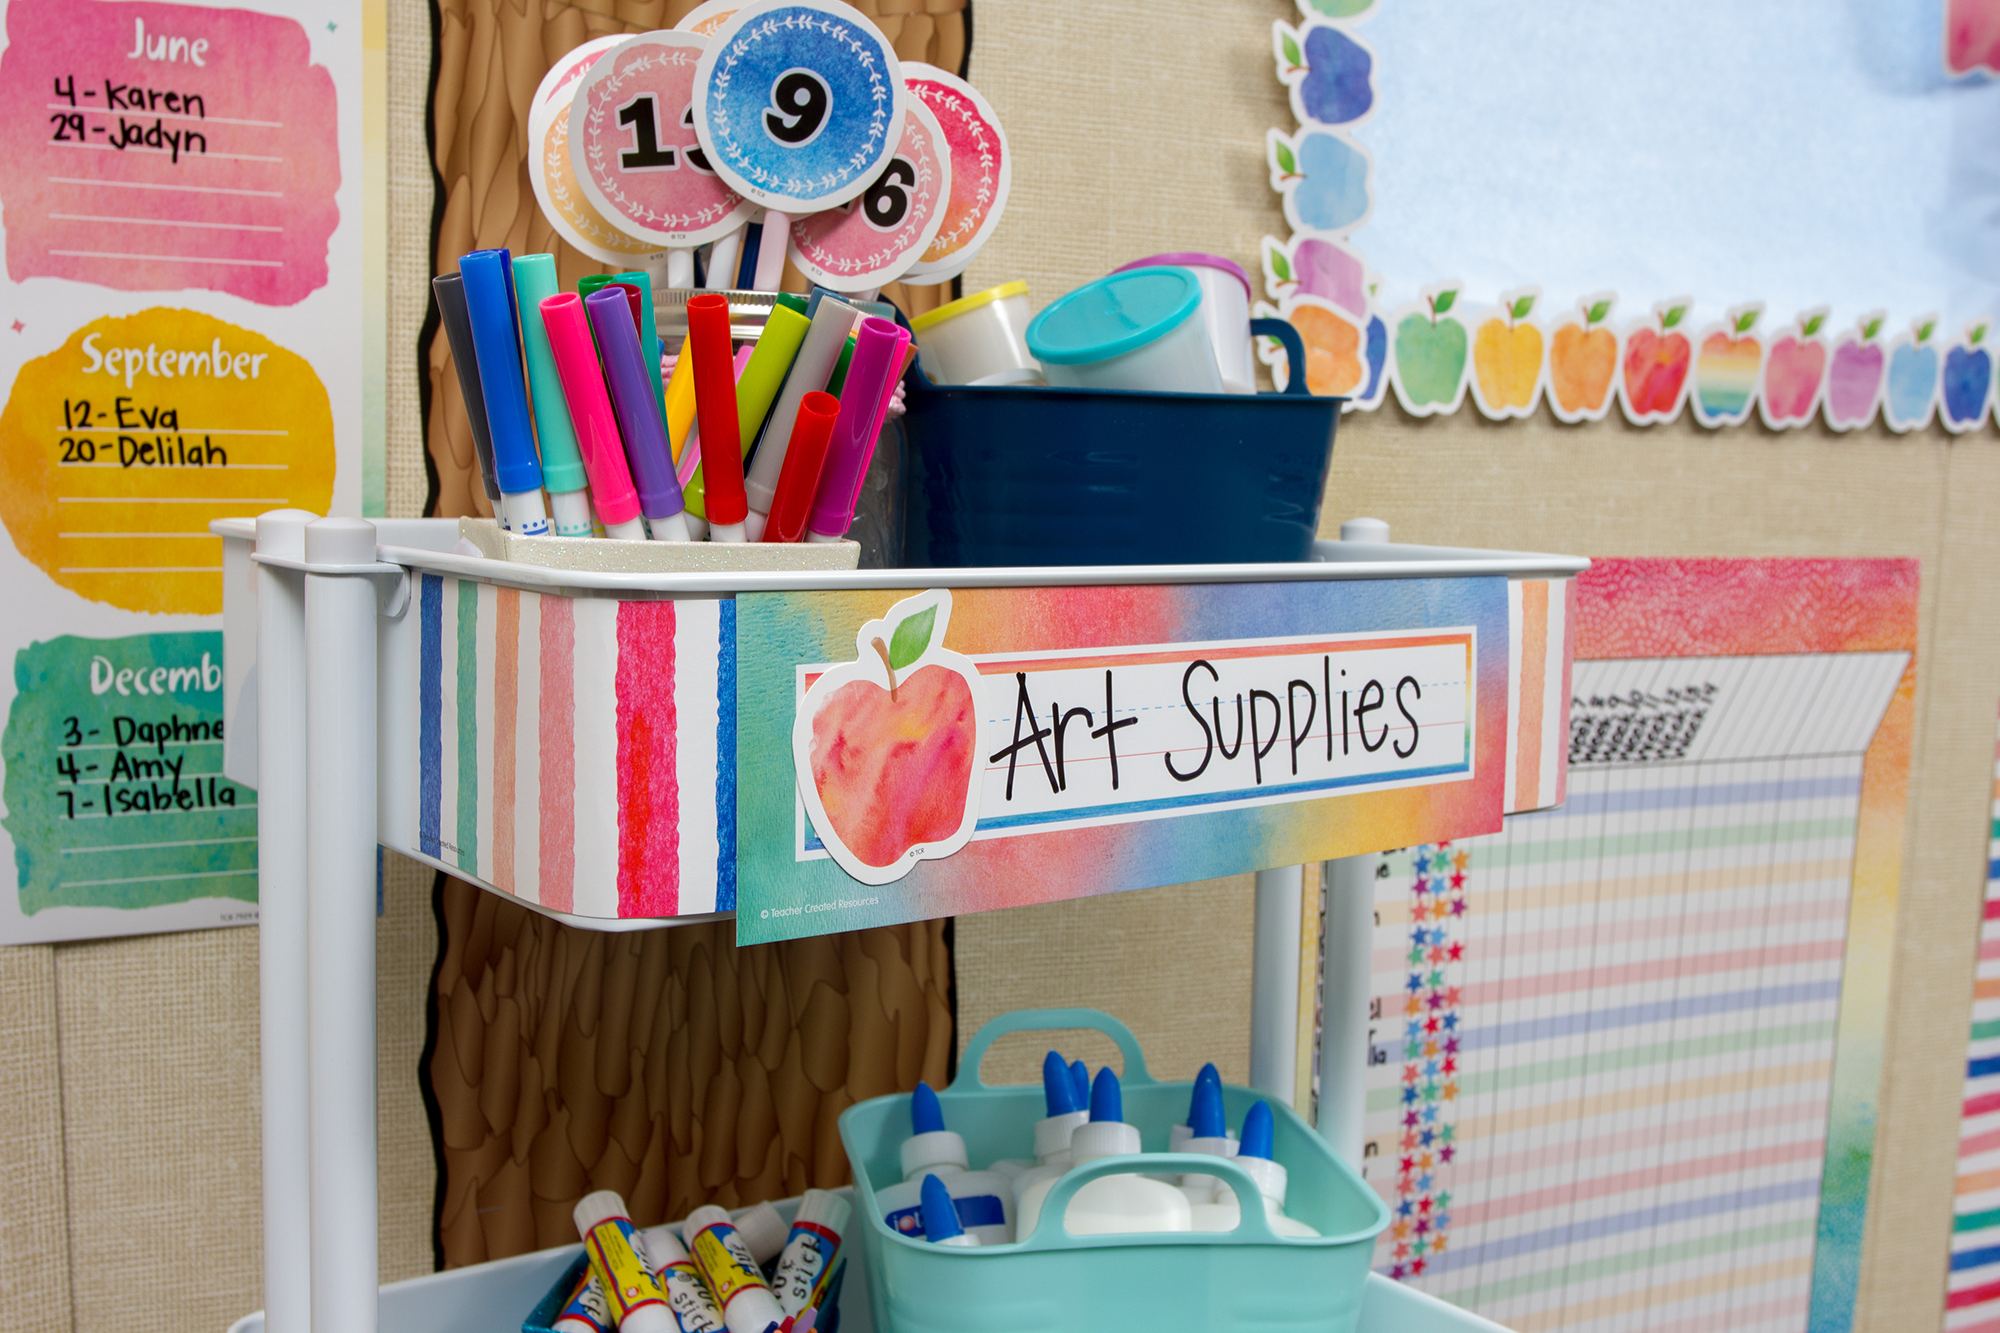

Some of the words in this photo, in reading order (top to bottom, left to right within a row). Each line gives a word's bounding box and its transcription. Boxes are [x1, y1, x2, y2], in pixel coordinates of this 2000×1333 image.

[127, 17, 209, 67] June
[766, 73, 827, 143] 9
[840, 157, 915, 228] 6
[81, 332, 268, 389] September
[90, 651, 223, 696] Decemb
[990, 670, 1137, 801] Art
[1165, 655, 1421, 784] Supplies
[771, 906, 802, 918] Teacher
[804, 900, 836, 914] Created
[838, 896, 879, 909] Resources
